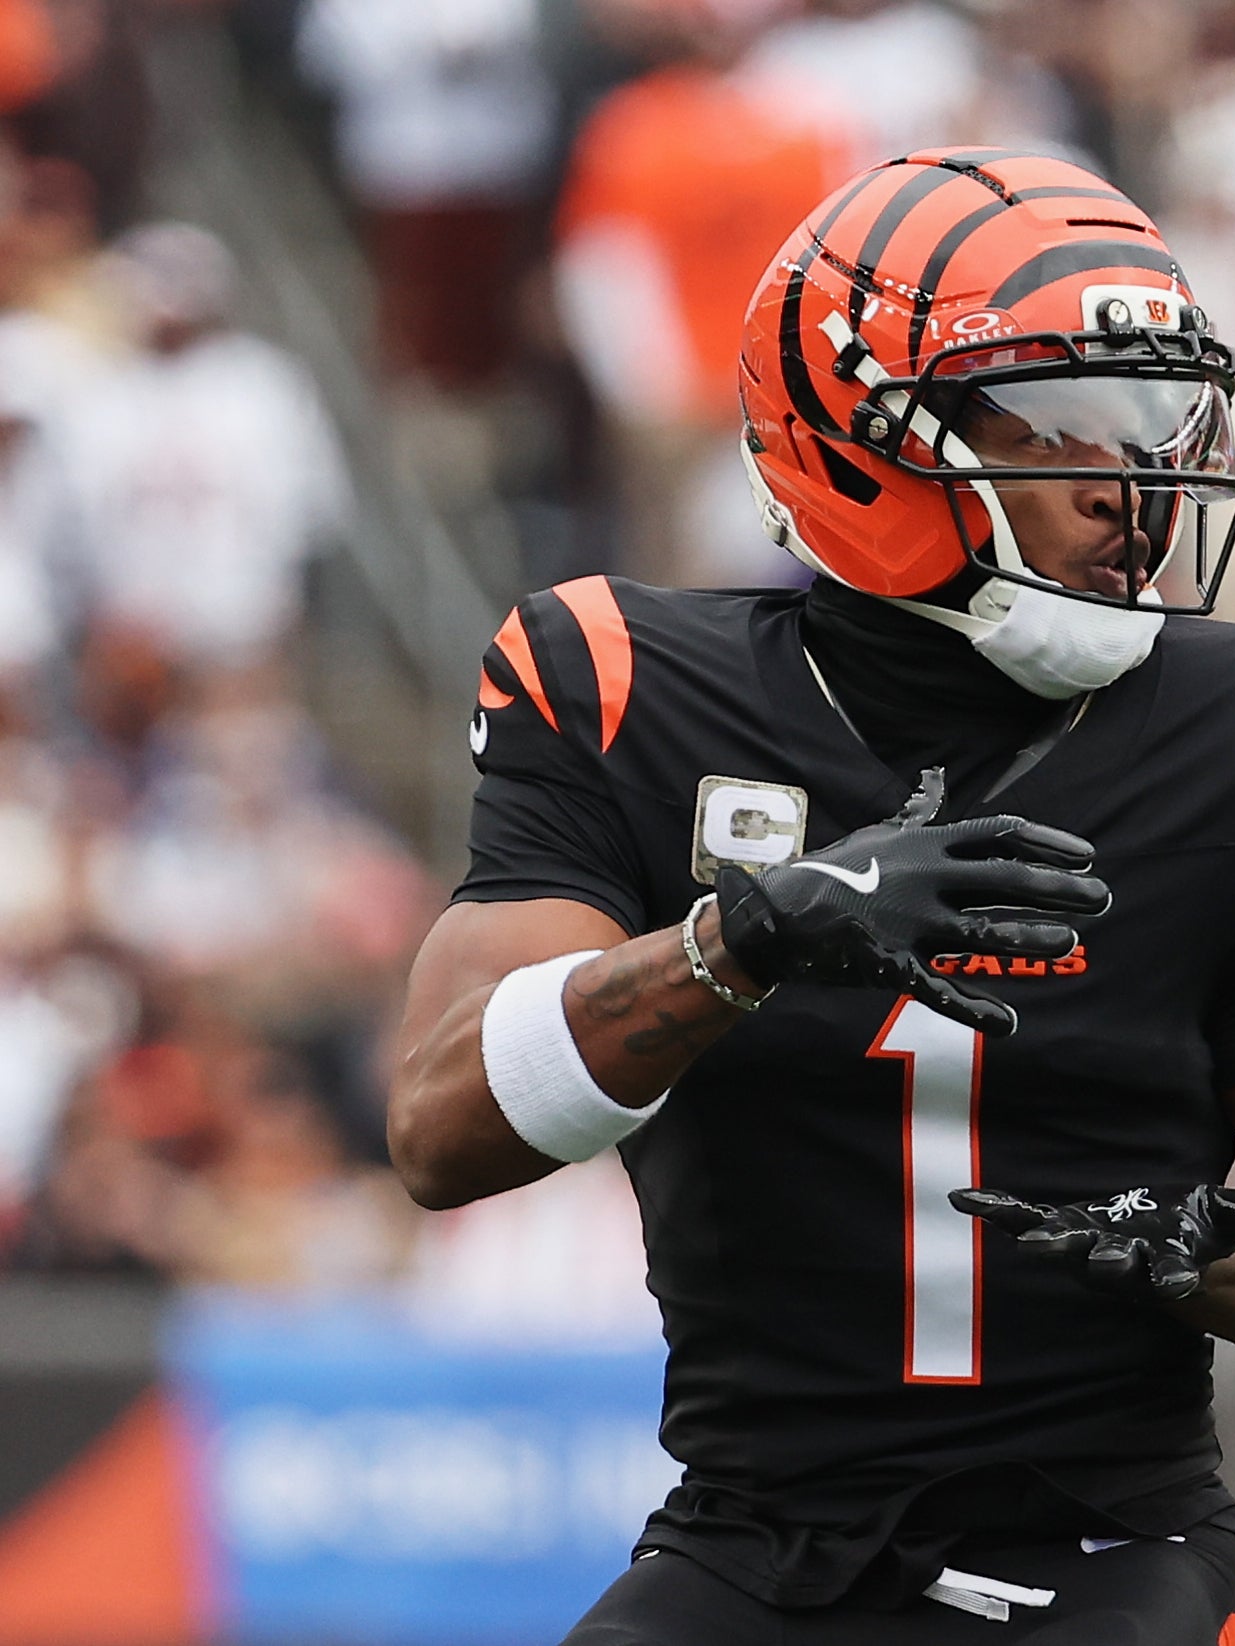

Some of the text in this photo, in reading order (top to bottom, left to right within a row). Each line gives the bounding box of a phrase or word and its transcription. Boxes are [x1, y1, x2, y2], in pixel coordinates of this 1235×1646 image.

[943, 324, 1017, 350] OAKLEY
[702, 785, 798, 864] C
[930, 945, 1088, 977] GALS
[865, 992, 983, 1386] 1
